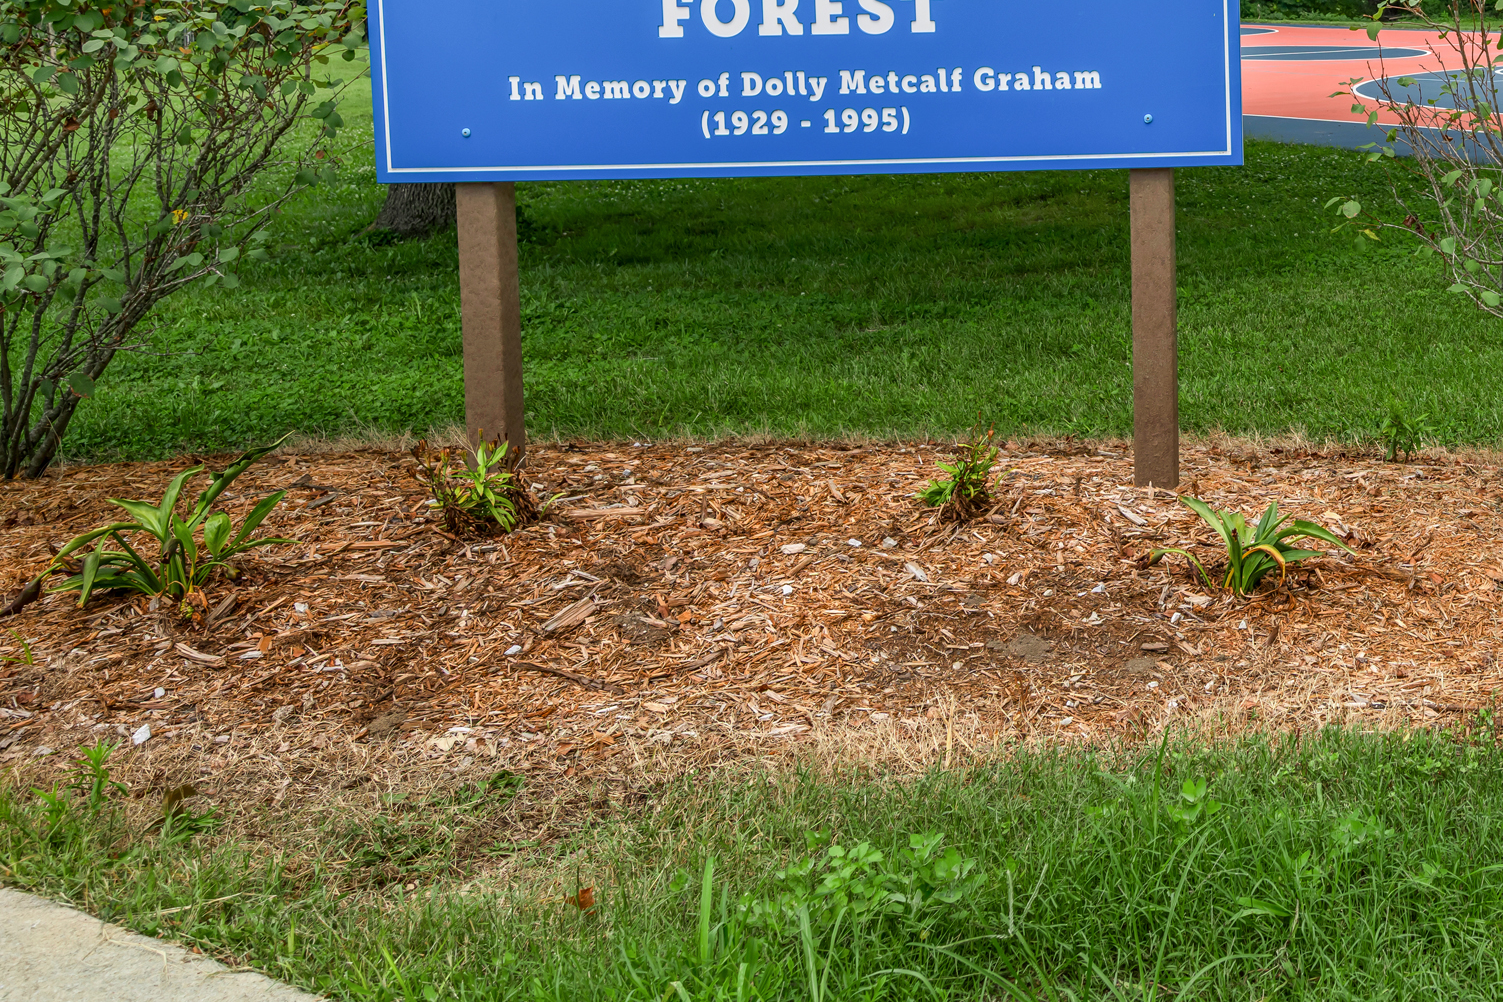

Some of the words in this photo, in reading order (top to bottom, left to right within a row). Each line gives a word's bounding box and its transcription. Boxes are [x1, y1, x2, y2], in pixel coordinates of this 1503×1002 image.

[508, 76, 544, 101] In
[555, 75, 687, 105] Memory
[697, 72, 730, 98] of
[740, 71, 828, 102] Dolly
[839, 67, 963, 95] Metcalf
[973, 66, 1102, 92] Graham
[701, 110, 788, 139] (1929
[823, 107, 910, 135] 1995)
